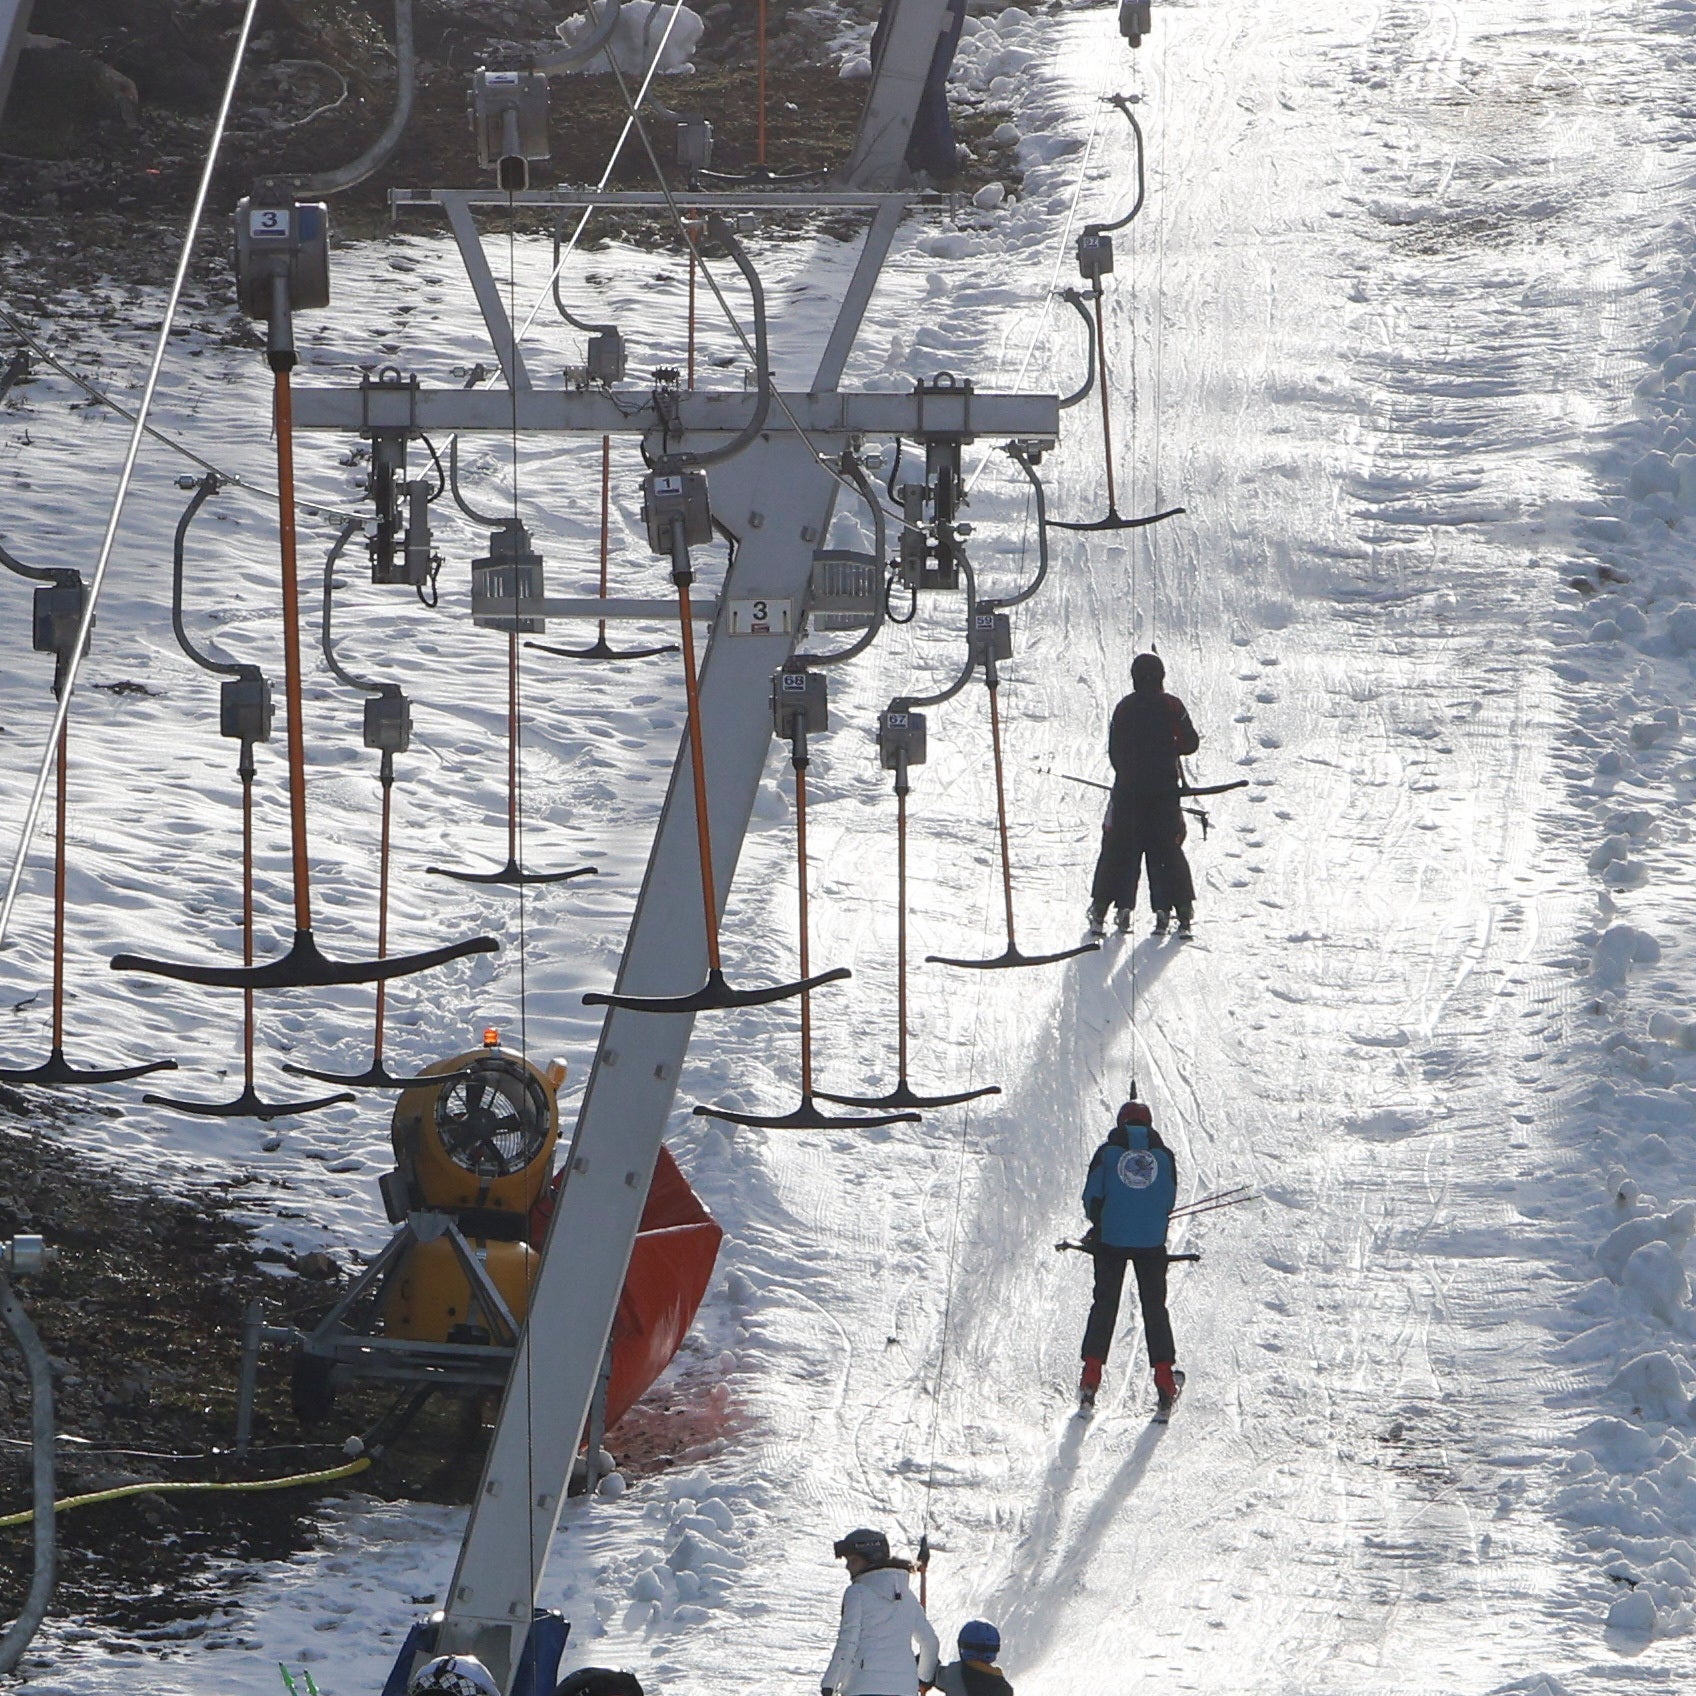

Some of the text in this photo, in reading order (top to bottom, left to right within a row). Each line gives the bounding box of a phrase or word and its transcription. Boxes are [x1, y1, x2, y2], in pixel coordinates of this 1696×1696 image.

[261, 211, 279, 228] 3
[662, 477, 671, 489] 1
[753, 601, 768, 621] 3
